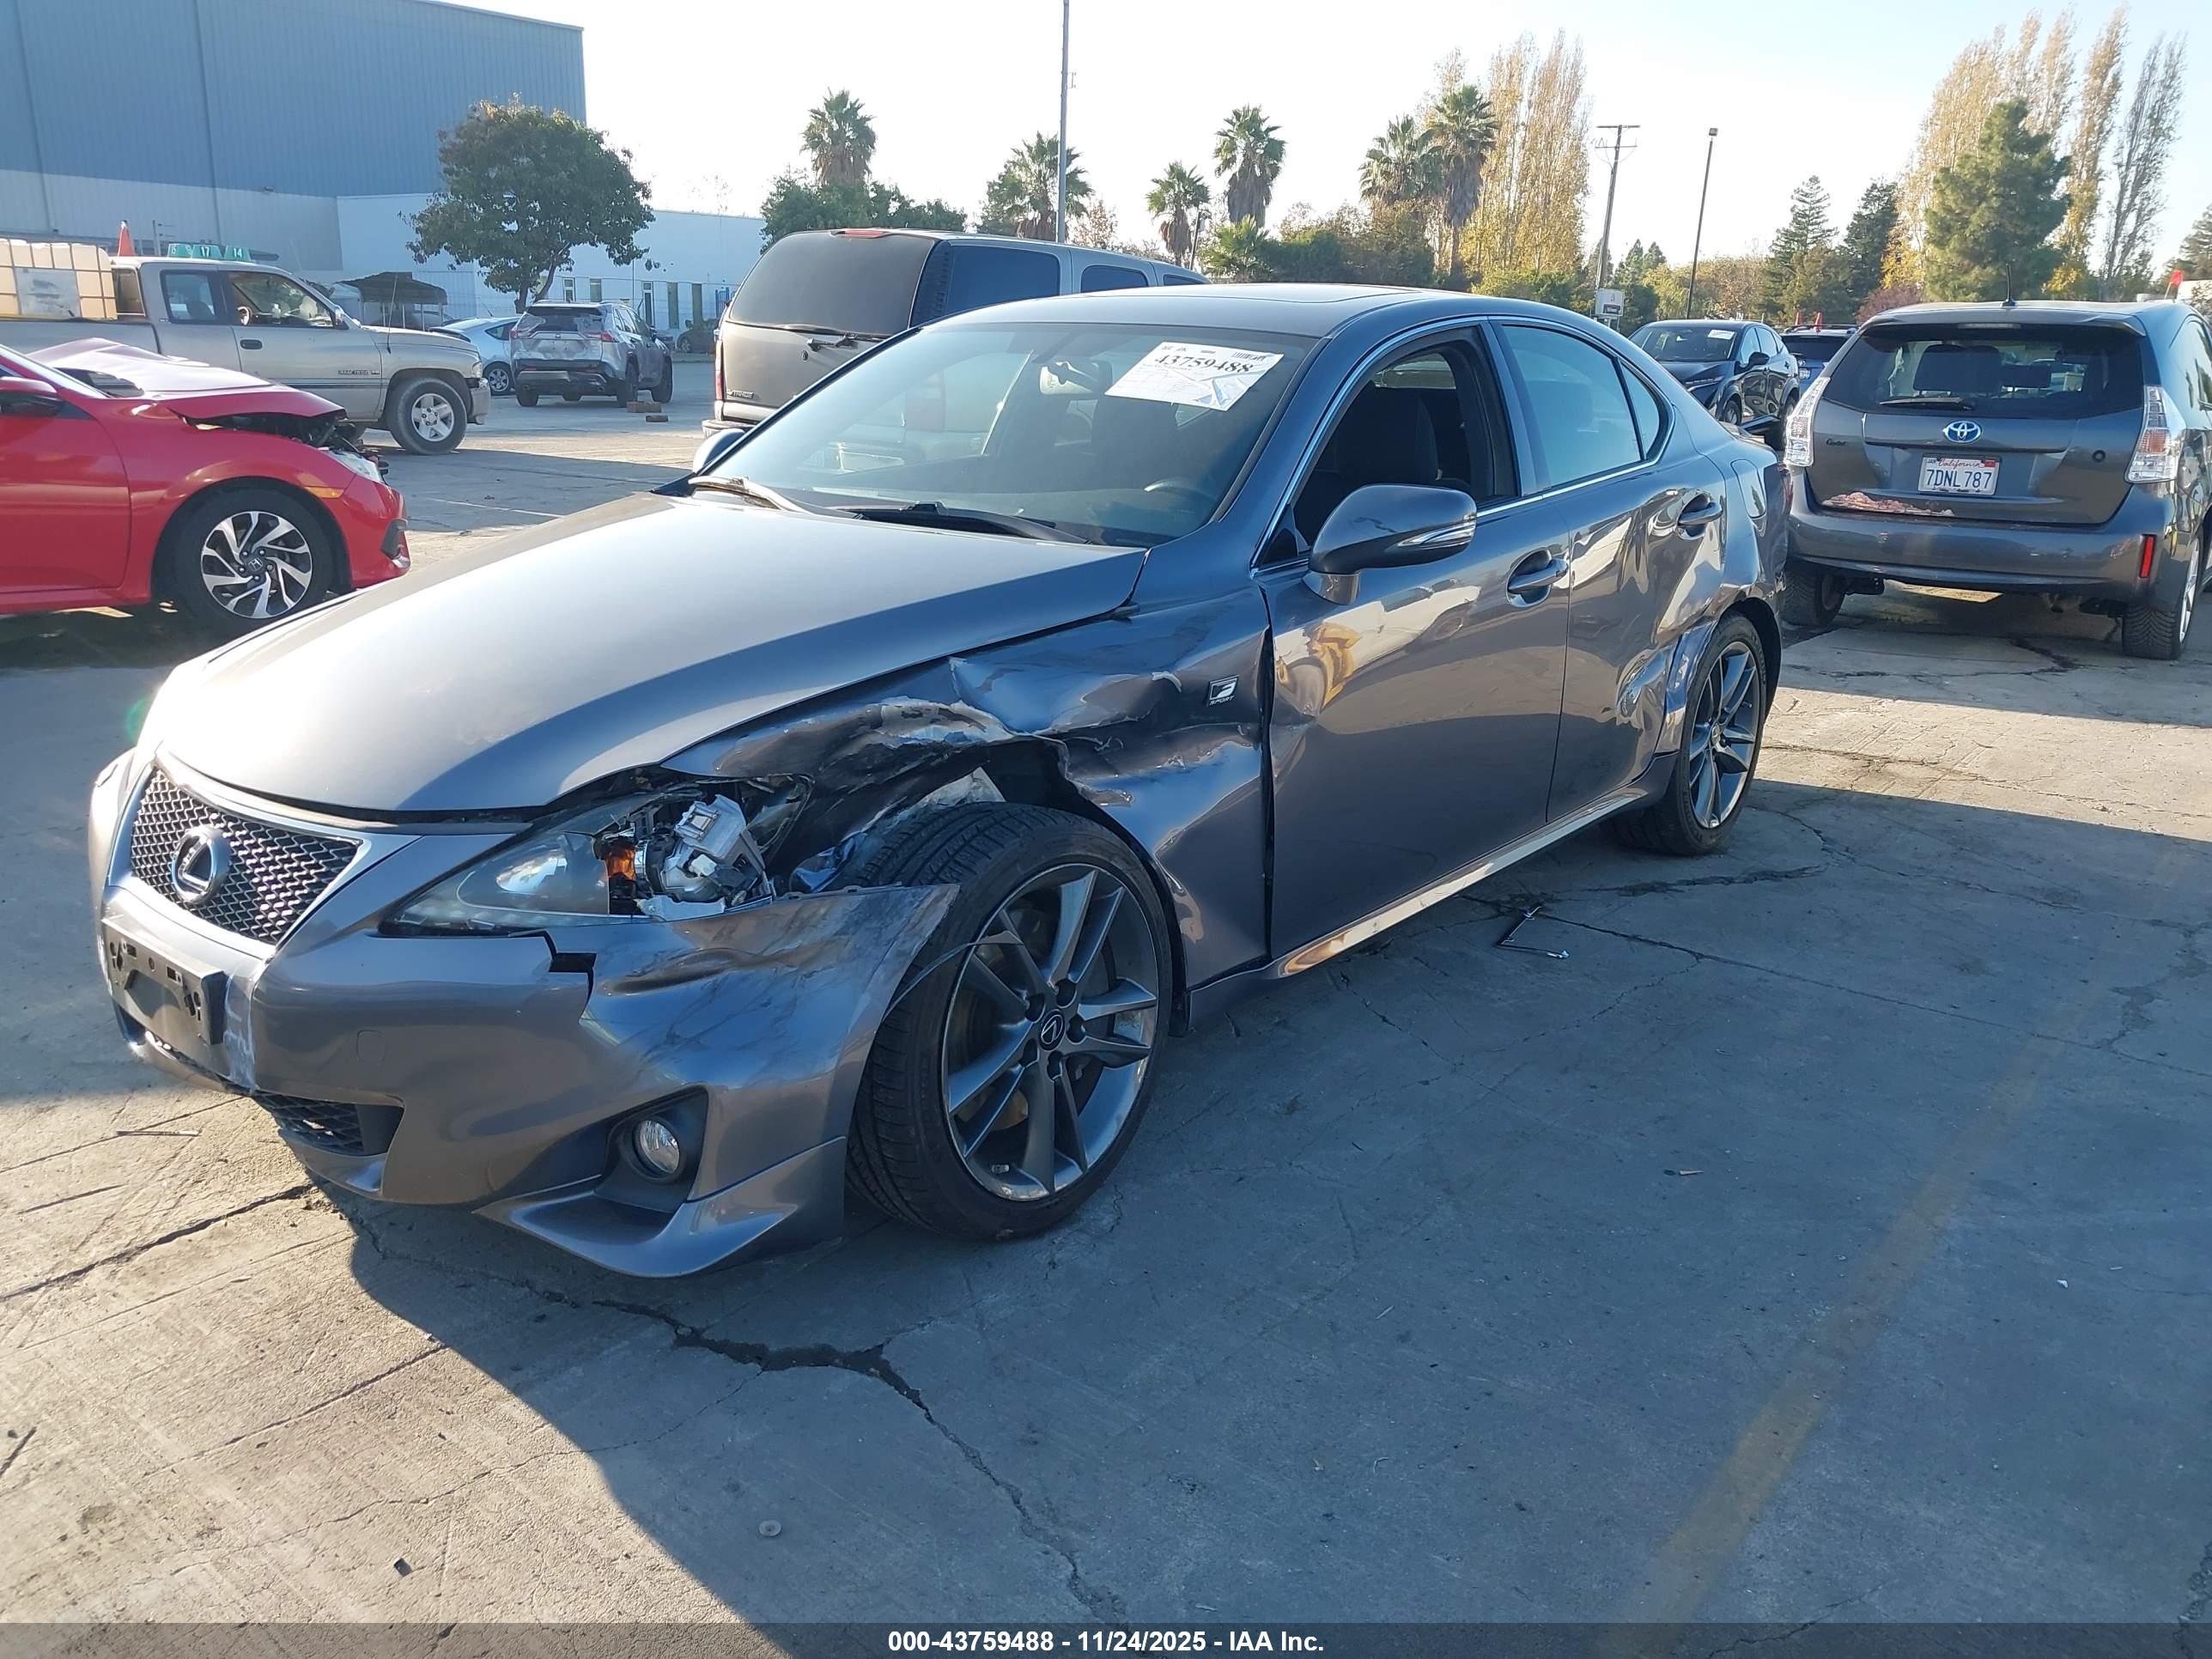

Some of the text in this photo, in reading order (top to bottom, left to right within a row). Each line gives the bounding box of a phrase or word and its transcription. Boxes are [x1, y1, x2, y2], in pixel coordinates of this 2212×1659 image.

[201, 247, 210, 258] 17
[234, 248, 242, 258] 14
[1155, 355, 1253, 372] 43759488
[1938, 459, 1984, 469] California
